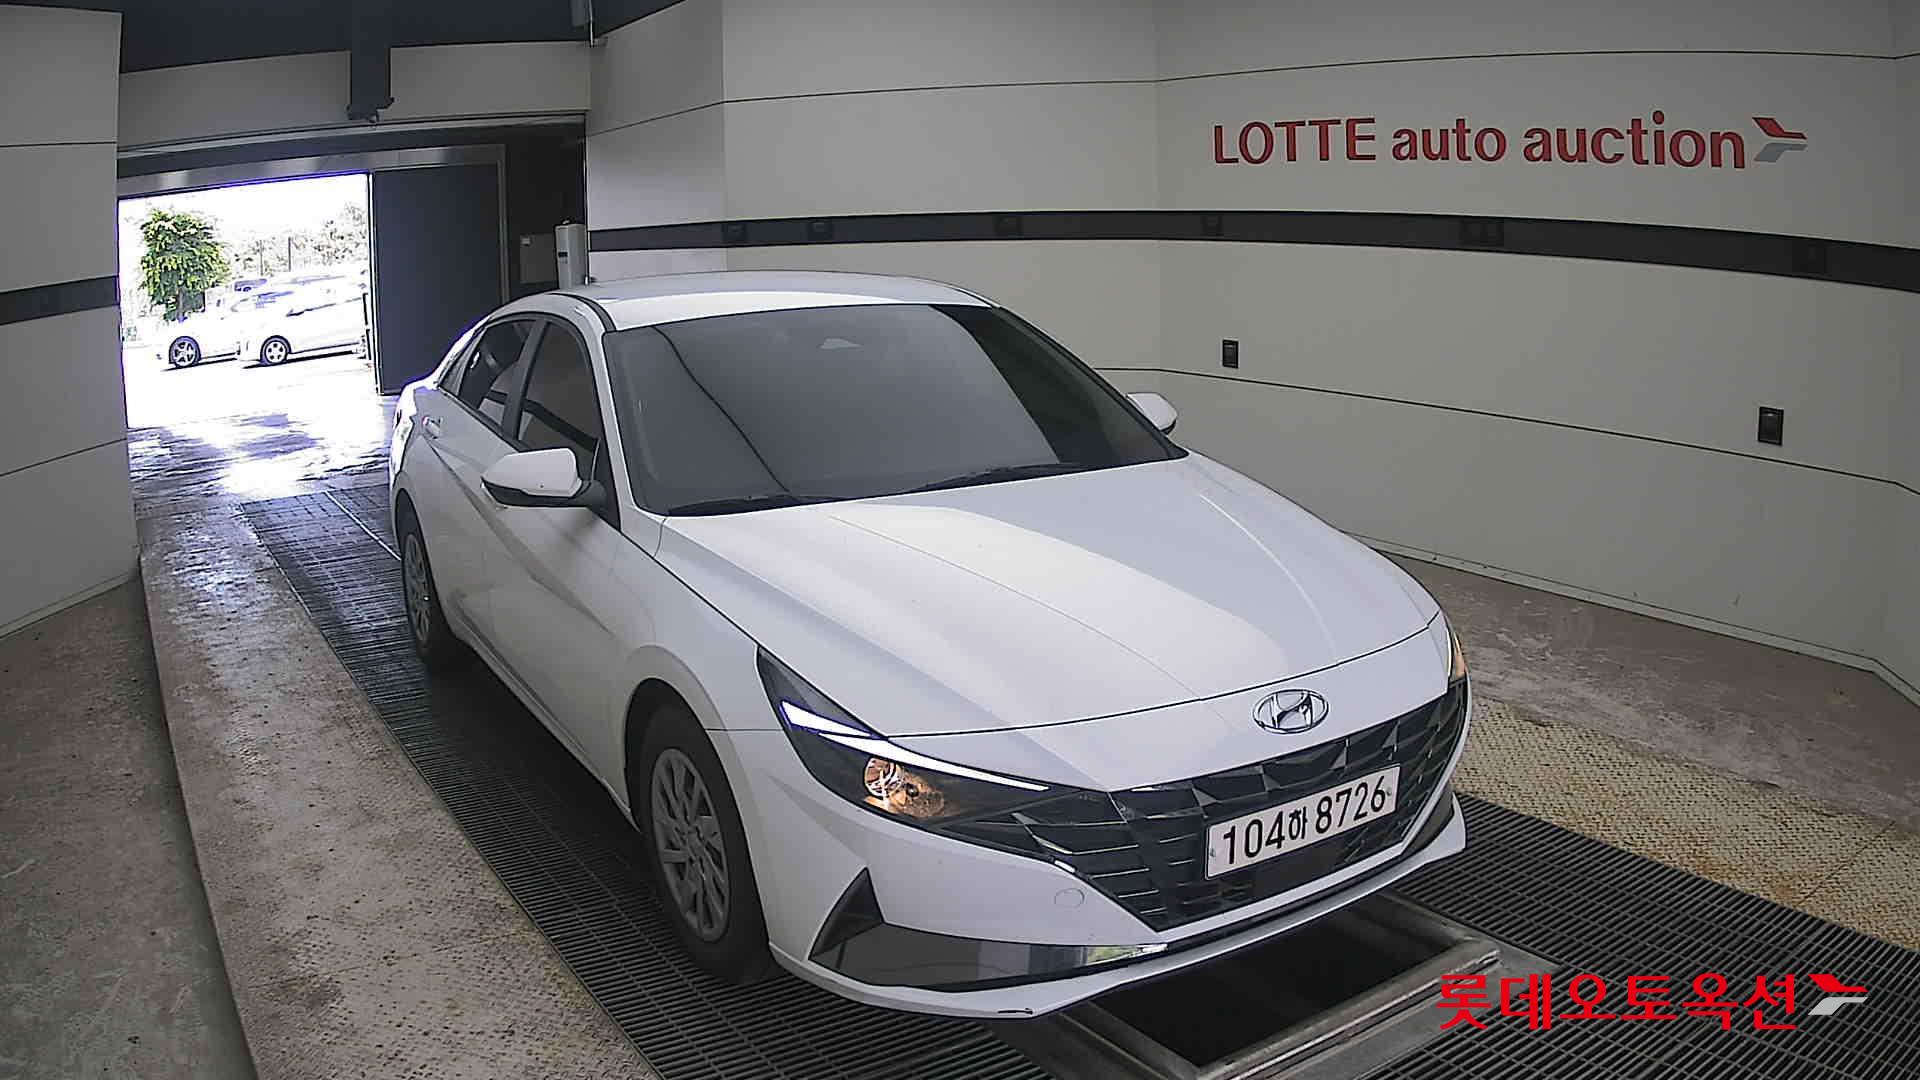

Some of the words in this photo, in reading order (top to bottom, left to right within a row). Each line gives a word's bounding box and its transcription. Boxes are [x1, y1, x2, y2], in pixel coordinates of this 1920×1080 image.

[1213, 116, 1377, 165] LOTTE
[1392, 117, 1507, 163] auto
[1523, 110, 1746, 169] auction
[1222, 805, 1308, 865] 104하
[1315, 775, 1387, 834] 8726
